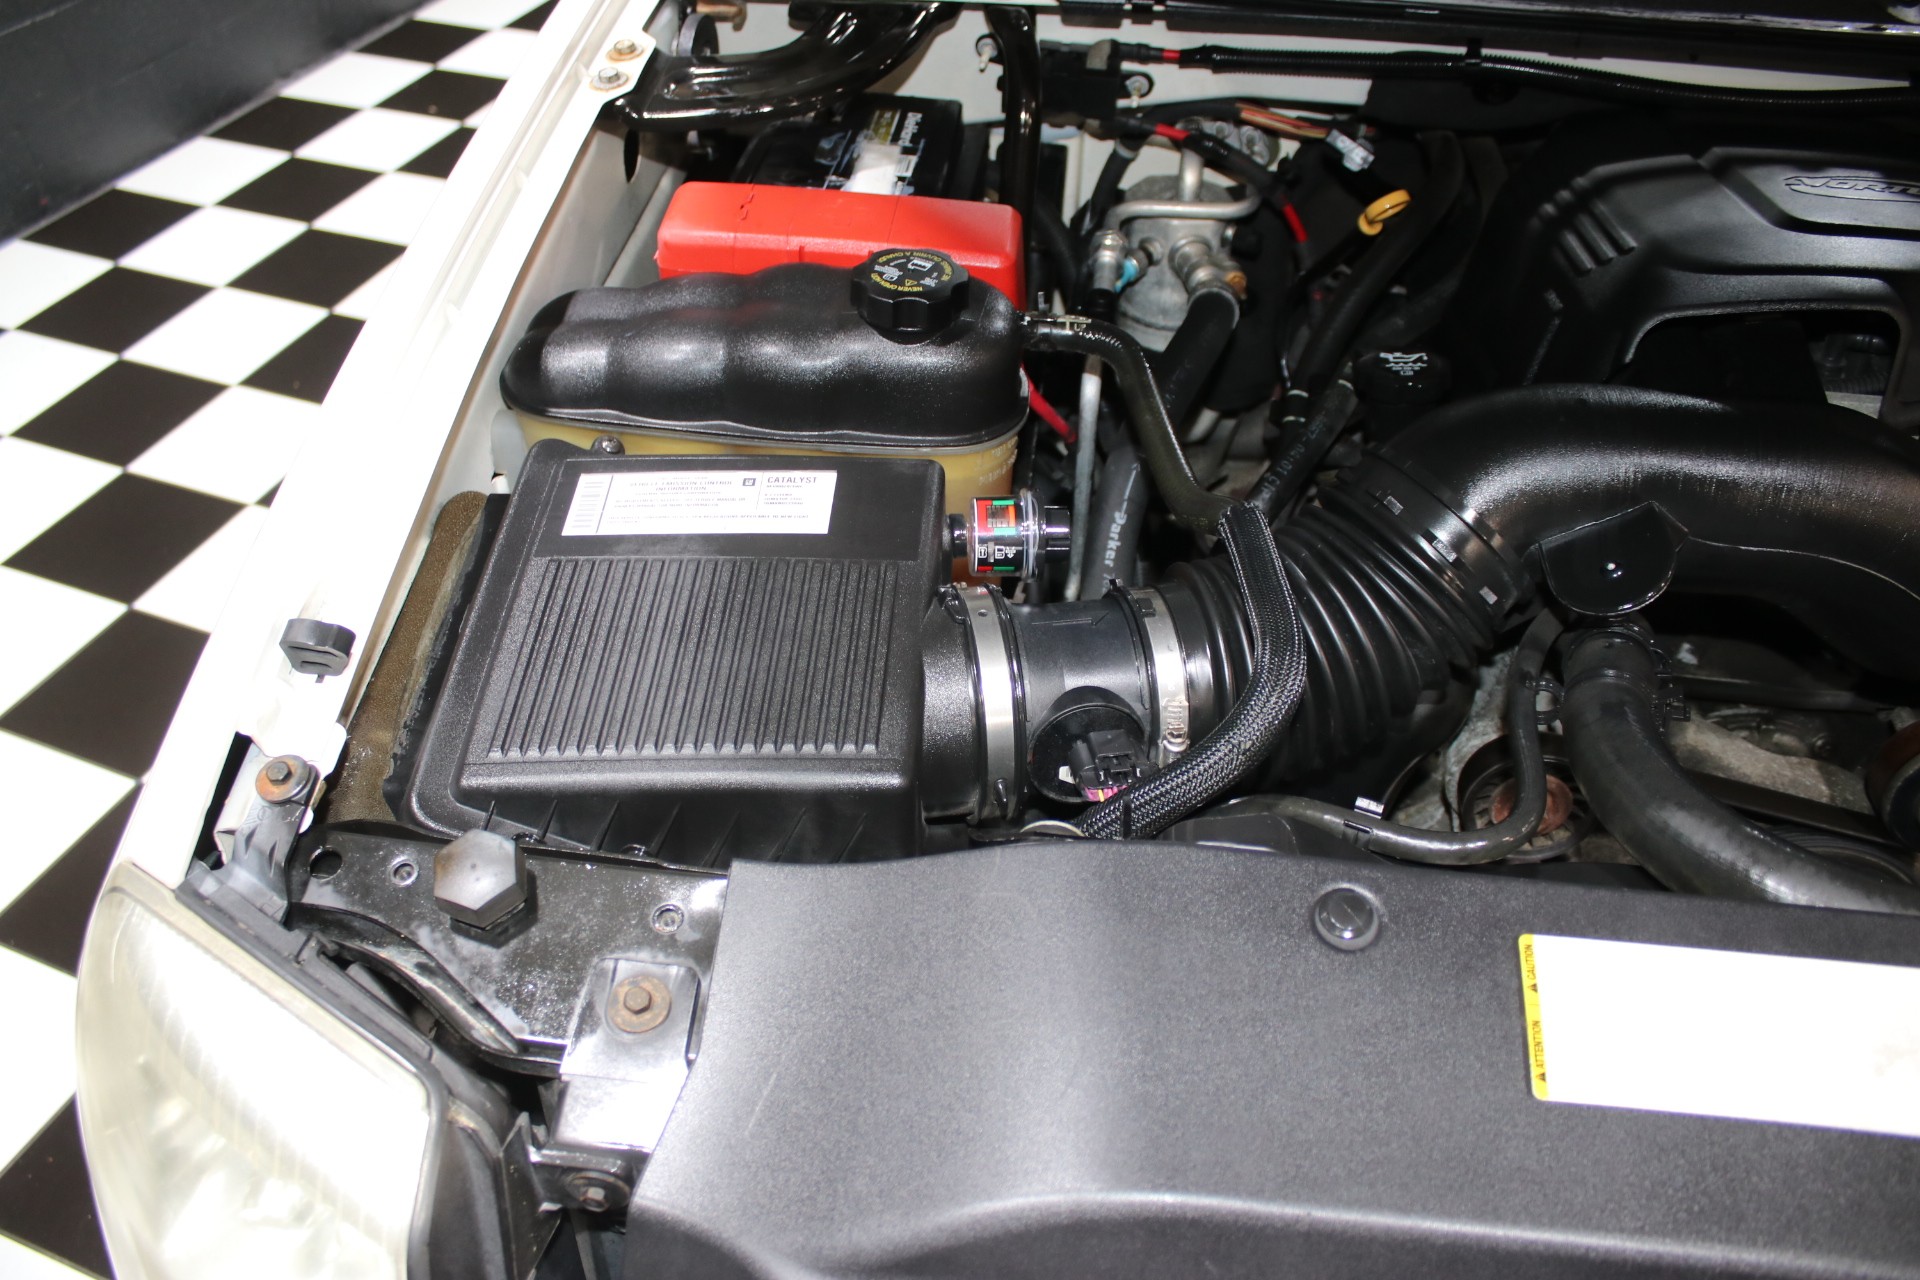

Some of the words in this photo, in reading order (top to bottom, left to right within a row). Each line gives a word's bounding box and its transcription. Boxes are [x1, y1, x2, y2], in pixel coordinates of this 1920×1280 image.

[767, 476, 818, 484] CATALYST
[1103, 511, 1128, 568] Parker
[1524, 944, 1536, 981] CAUTION
[1532, 1020, 1546, 1069] ATTENTION
